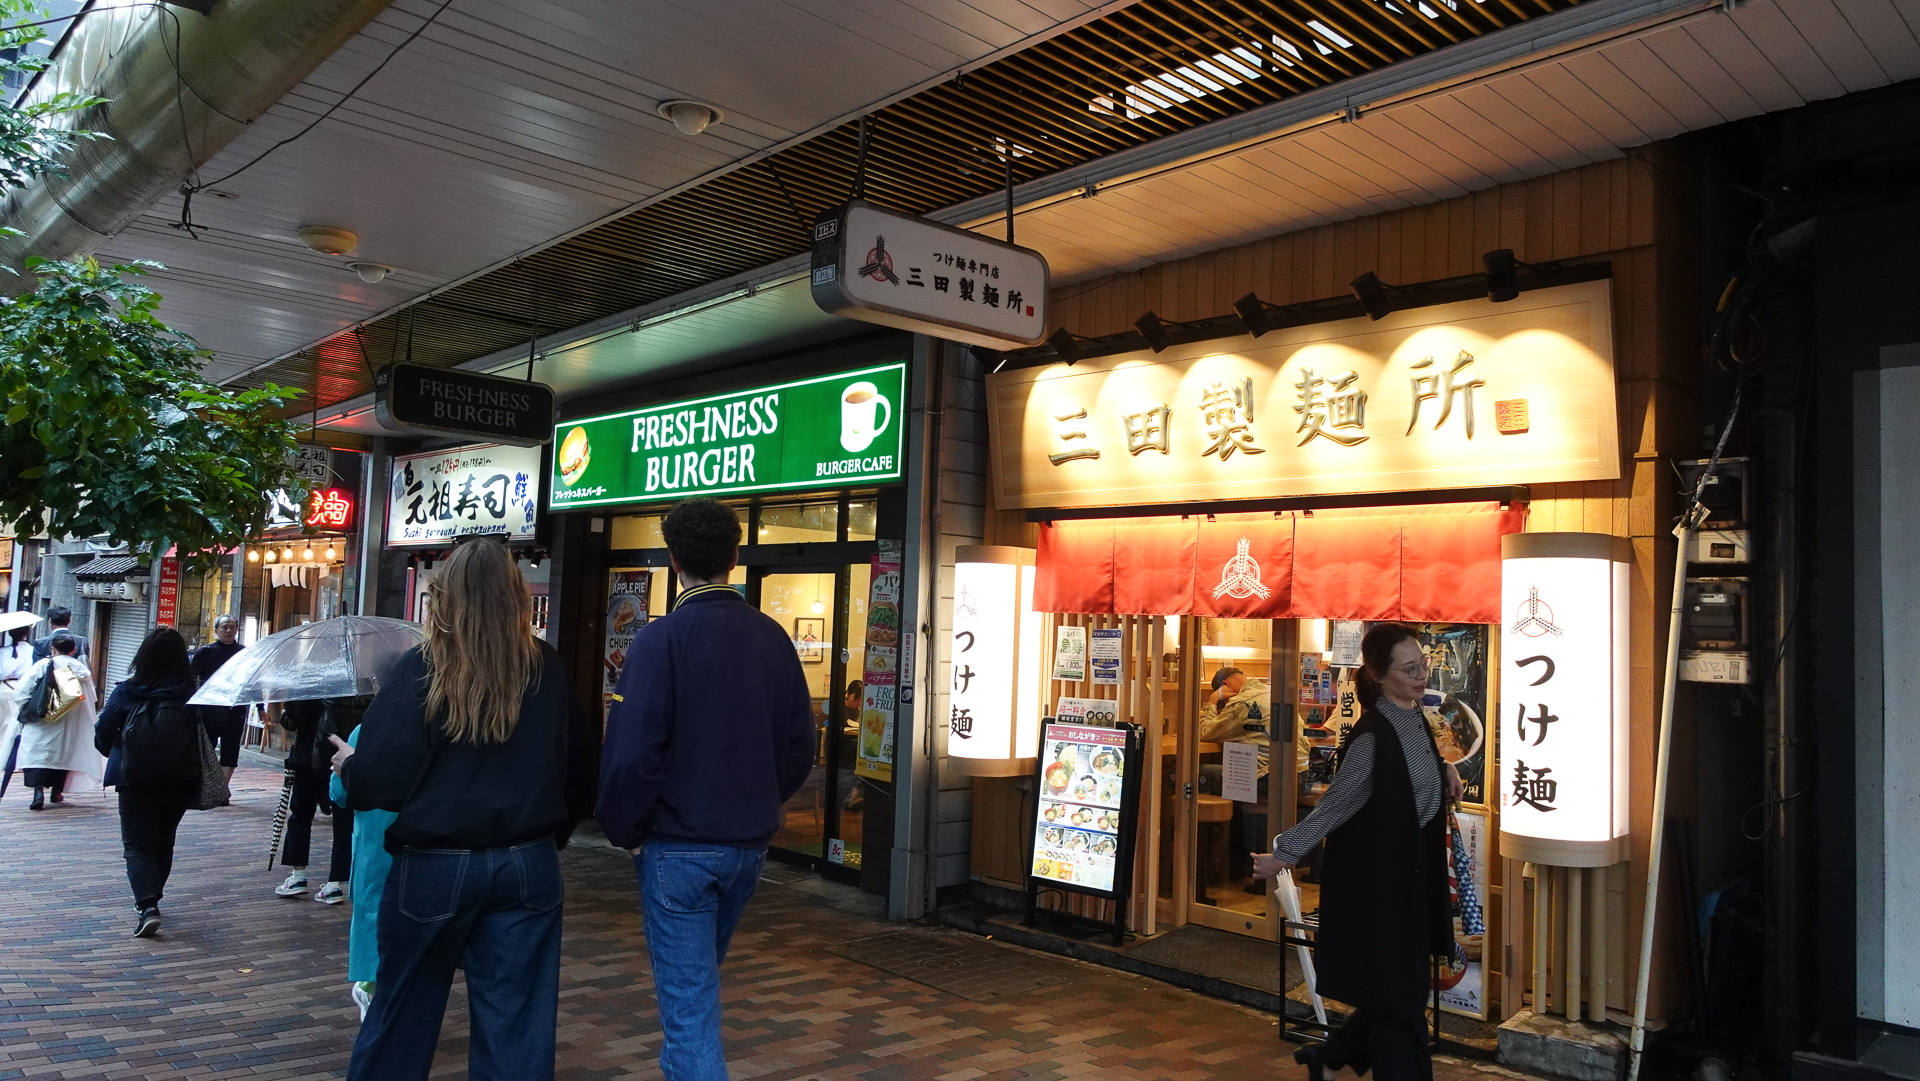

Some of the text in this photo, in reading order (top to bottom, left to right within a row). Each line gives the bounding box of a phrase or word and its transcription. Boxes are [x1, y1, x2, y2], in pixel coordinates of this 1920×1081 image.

[933, 252, 1000, 279] つけ麺専門店
[906, 267, 1024, 314] 三田製麺所
[419, 378, 530, 411] FRESHNESS
[1048, 348, 1487, 468] 三田製麺所
[433, 401, 517, 428] BURGER
[631, 393, 779, 453] FRESHNESS
[645, 443, 756, 492] BURGER
[815, 455, 893, 476] BURGER CAFE
[554, 485, 607, 500] フレッシュネスバーガー
[404, 528, 423, 539] Sushi
[612, 581, 646, 595] APPLE PIE
[950, 630, 976, 741] つけ麺
[1068, 730, 1097, 741] おしながき
[1511, 654, 1560, 813] つけ麺
